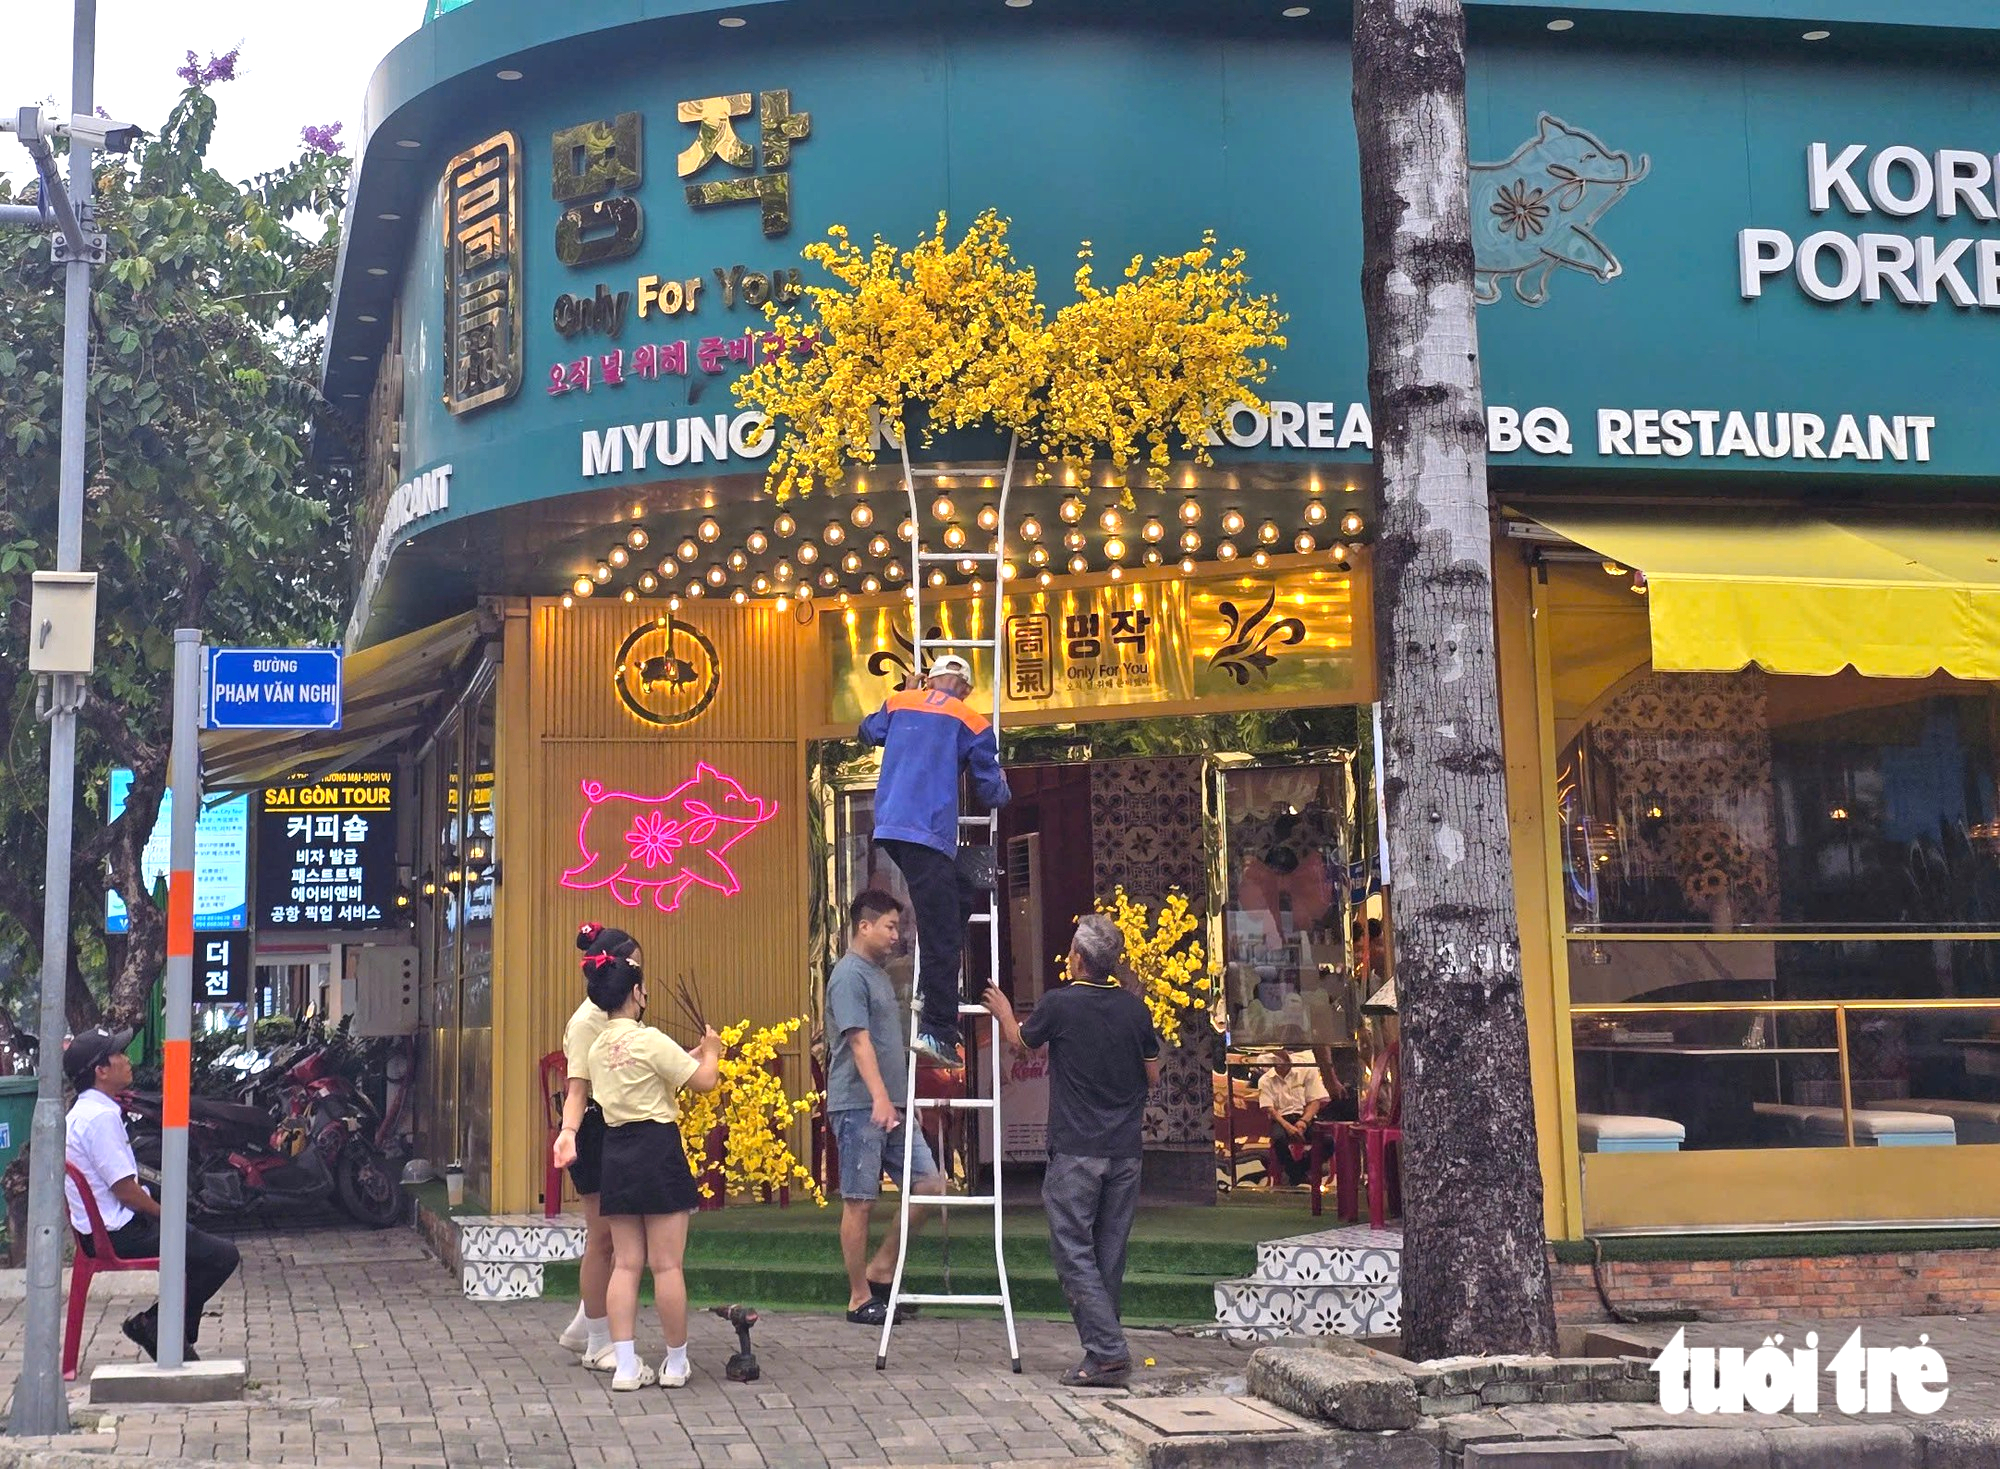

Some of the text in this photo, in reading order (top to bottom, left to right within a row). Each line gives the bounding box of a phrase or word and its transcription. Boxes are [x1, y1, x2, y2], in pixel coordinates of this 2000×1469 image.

[552, 89, 811, 267] 명작
[1807, 142, 2000, 221] KOR
[553, 264, 802, 338] Only For You
[546, 355, 592, 396] 오직
[599, 348, 625, 386] 널
[632, 339, 689, 379] 위해
[582, 410, 776, 477] MYUNG
[1188, 400, 1935, 462] OREA BQ RESTAURANT
[1066, 610, 1151, 659] 명작
[253, 656, 298, 673] ĐƯỜNG
[1067, 661, 1148, 681] Only For You
[215, 681, 336, 706] PHẠM VĂN NGHỊ
[299, 784, 338, 805] GÒN
[342, 786, 391, 804] TOUR
[286, 814, 369, 843] 커피숍
[296, 848, 358, 866] 비자 발급
[291, 867, 363, 884] 패스트트랙
[291, 885, 362, 902] 에어비앤비
[271, 905, 381, 923] 공항 픽업 서비스
